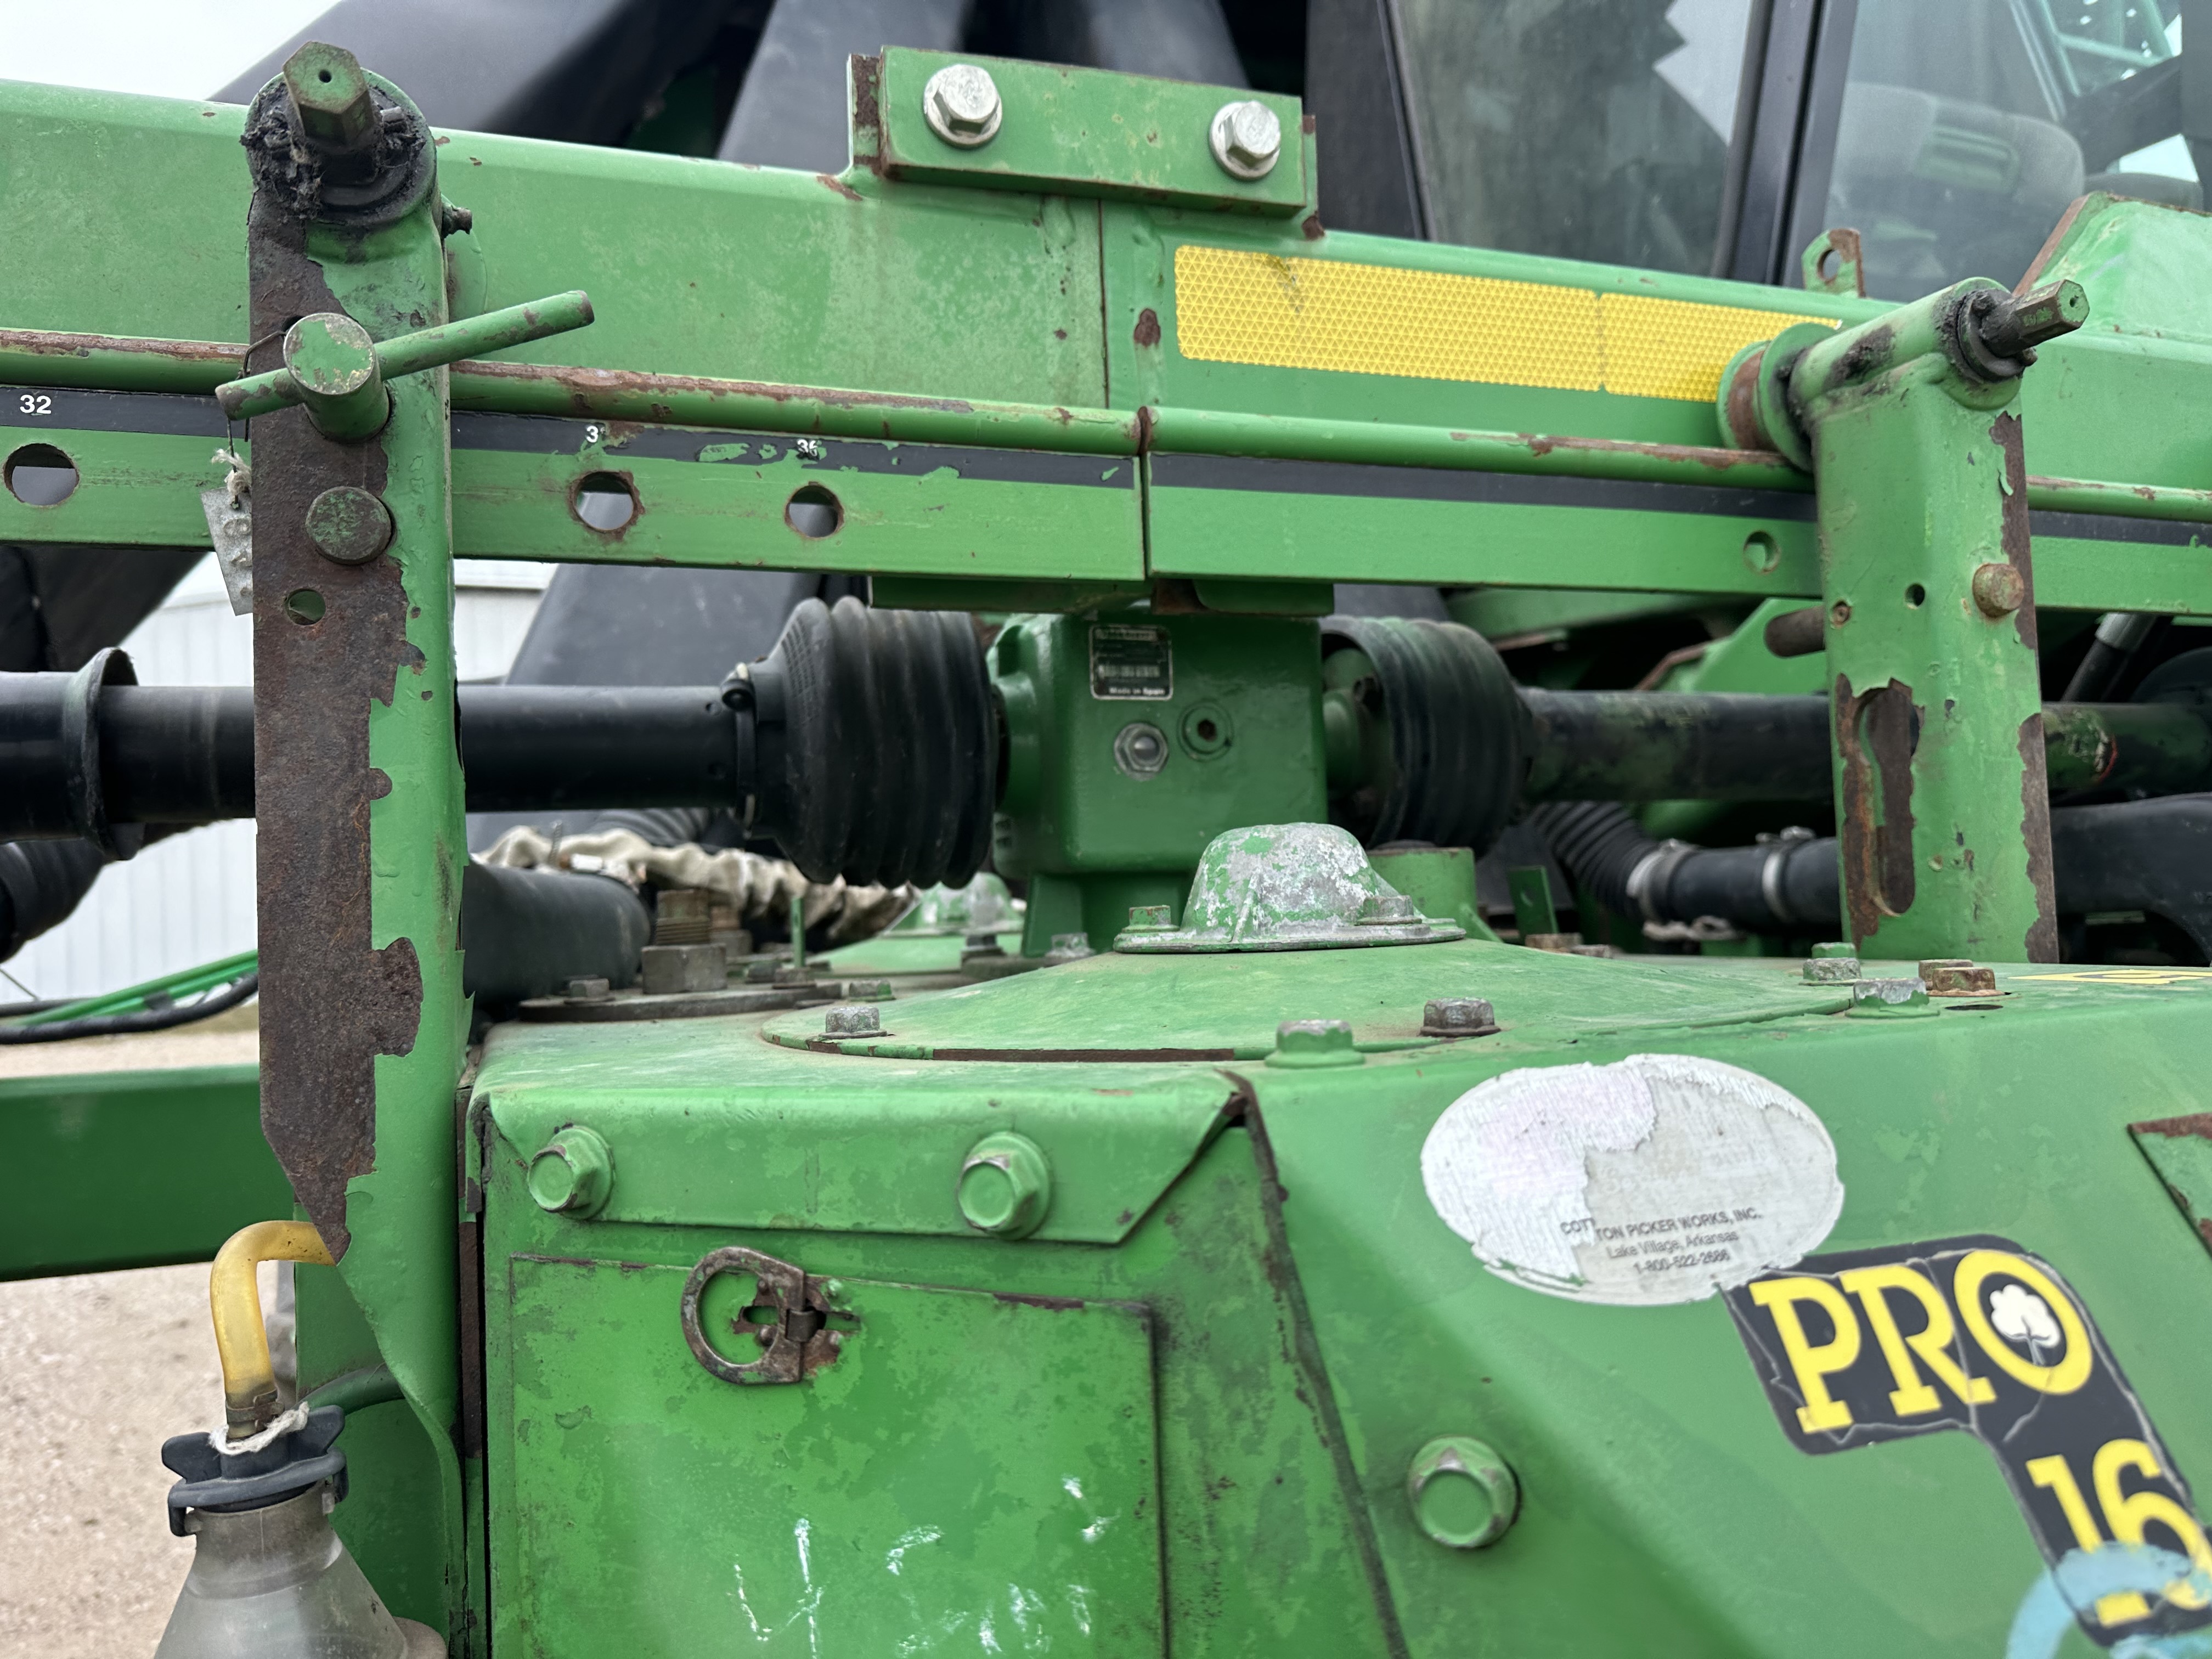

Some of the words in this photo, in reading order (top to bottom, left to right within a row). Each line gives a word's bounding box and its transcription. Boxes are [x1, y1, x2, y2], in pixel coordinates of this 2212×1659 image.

[19, 394, 52, 415] 32
[1626, 1218, 1678, 1237] PICKER
[1677, 1210, 1734, 1230] WORKS,
[1732, 1206, 1763, 1222] INC.
[1606, 1244, 1638, 1259] Lake
[1637, 1239, 1685, 1255] Village,
[1685, 1231, 1739, 1248] Arkansas
[1748, 1249, 2093, 1435] PRO
